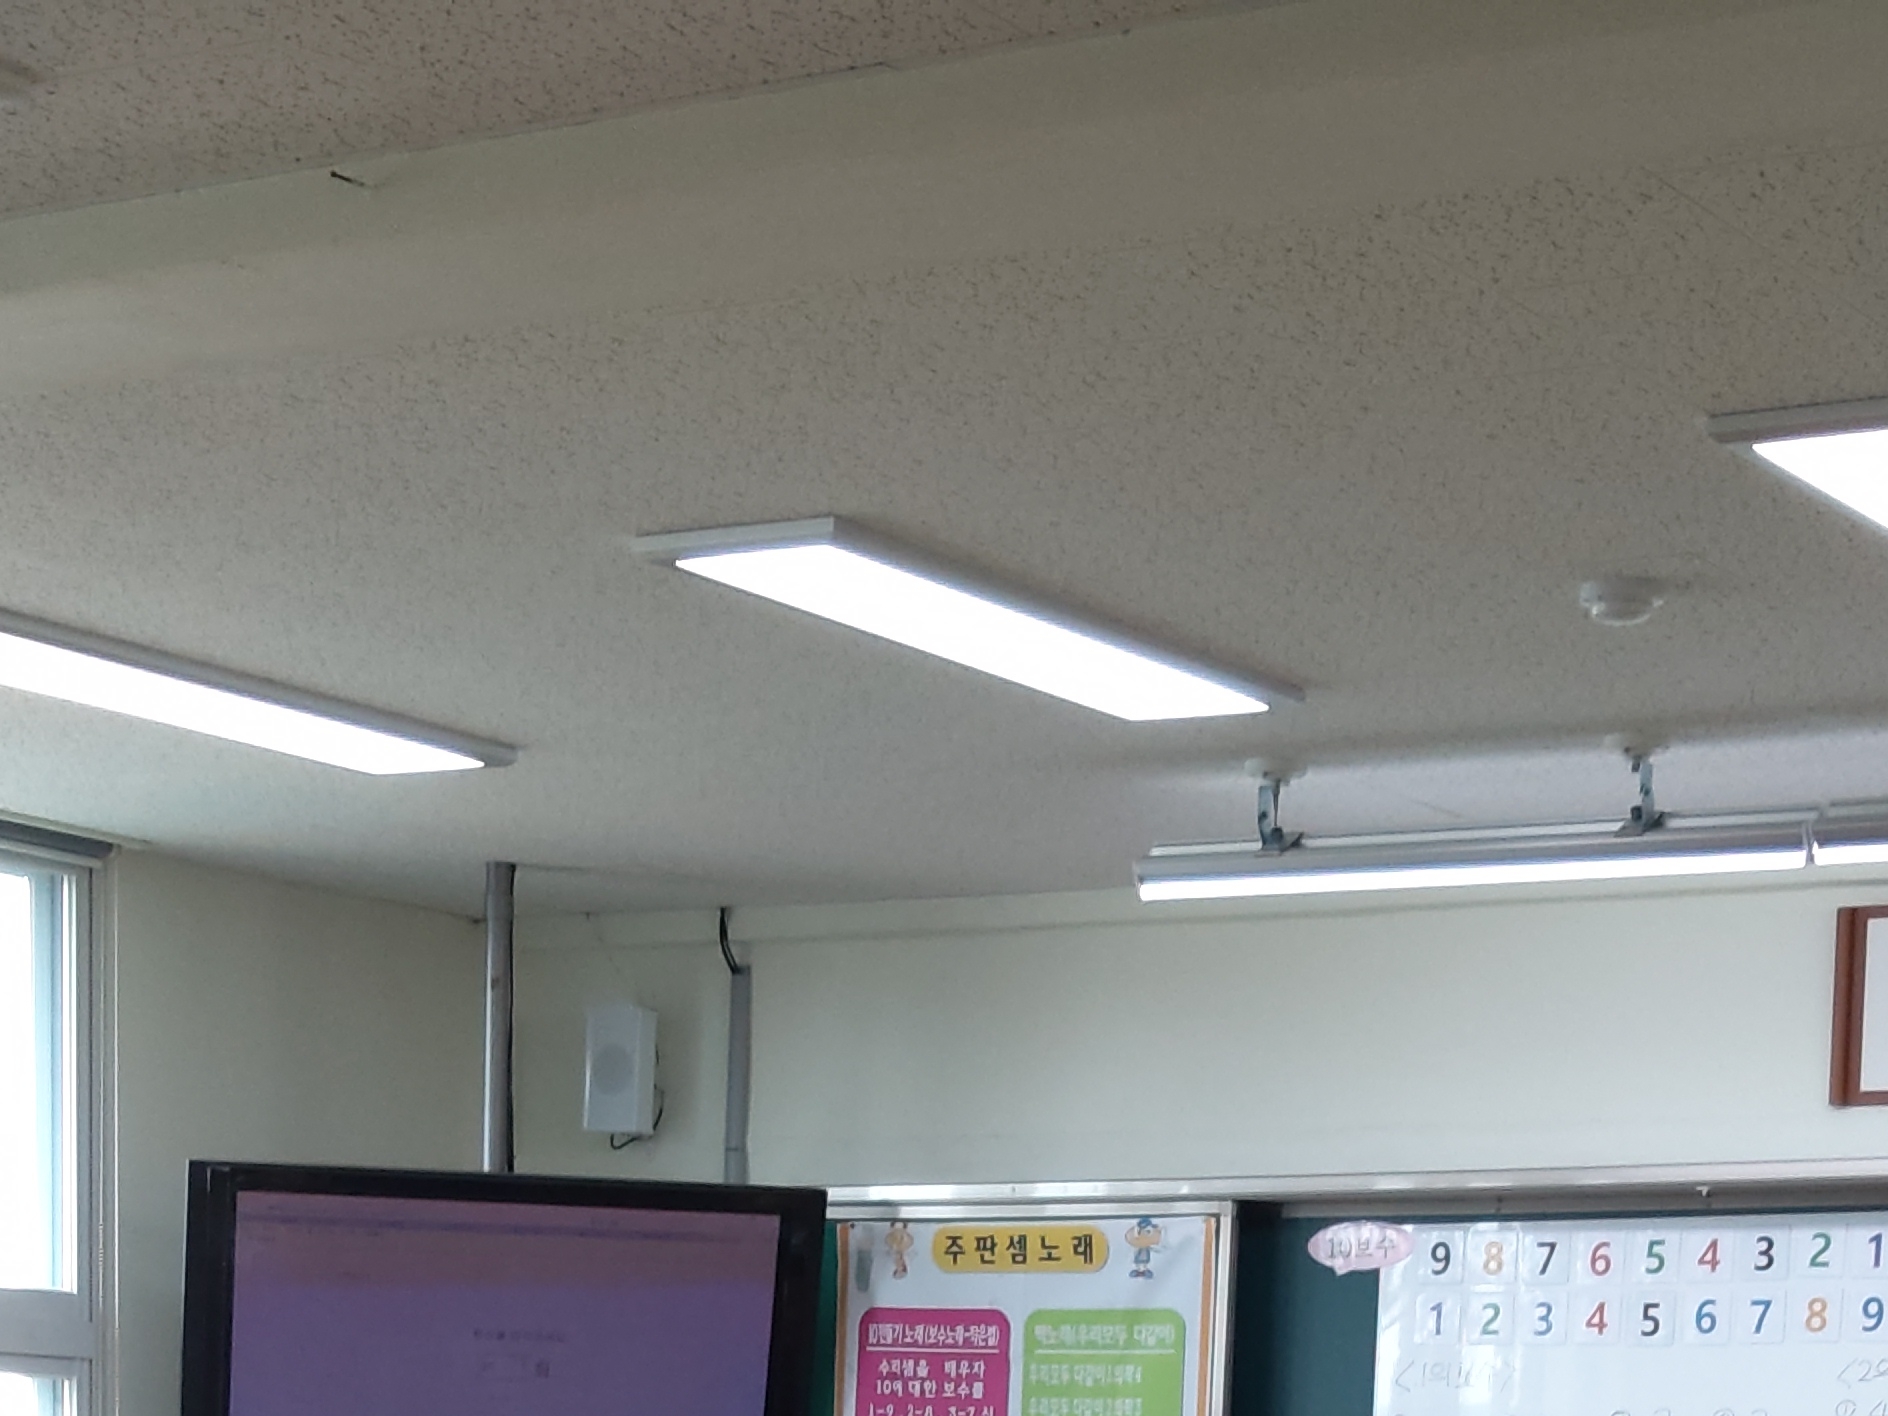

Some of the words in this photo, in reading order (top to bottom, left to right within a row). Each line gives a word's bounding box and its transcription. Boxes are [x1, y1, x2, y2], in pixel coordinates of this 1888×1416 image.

[1431, 1242, 1450, 1275] 9
[1481, 1239, 1504, 1275] 8
[1537, 1242, 1557, 1275] 7
[1591, 1242, 1611, 1276] 6
[1646, 1240, 1665, 1274] 5
[1698, 1239, 1720, 1272] 4
[1754, 1237, 1774, 1271] 3
[1809, 1233, 1831, 1267] 2
[1869, 1233, 1882, 1268] 1
[1430, 1302, 1442, 1335] 1
[1481, 1303, 1500, 1335] 2
[1534, 1302, 1552, 1336] 3
[1586, 1302, 1608, 1335] 4
[1641, 1303, 1660, 1336] 5
[1696, 1300, 1716, 1334] 6
[1751, 1300, 1772, 1334] 7
[1806, 1298, 1827, 1332] 8
[1862, 1297, 1884, 1332] 9
